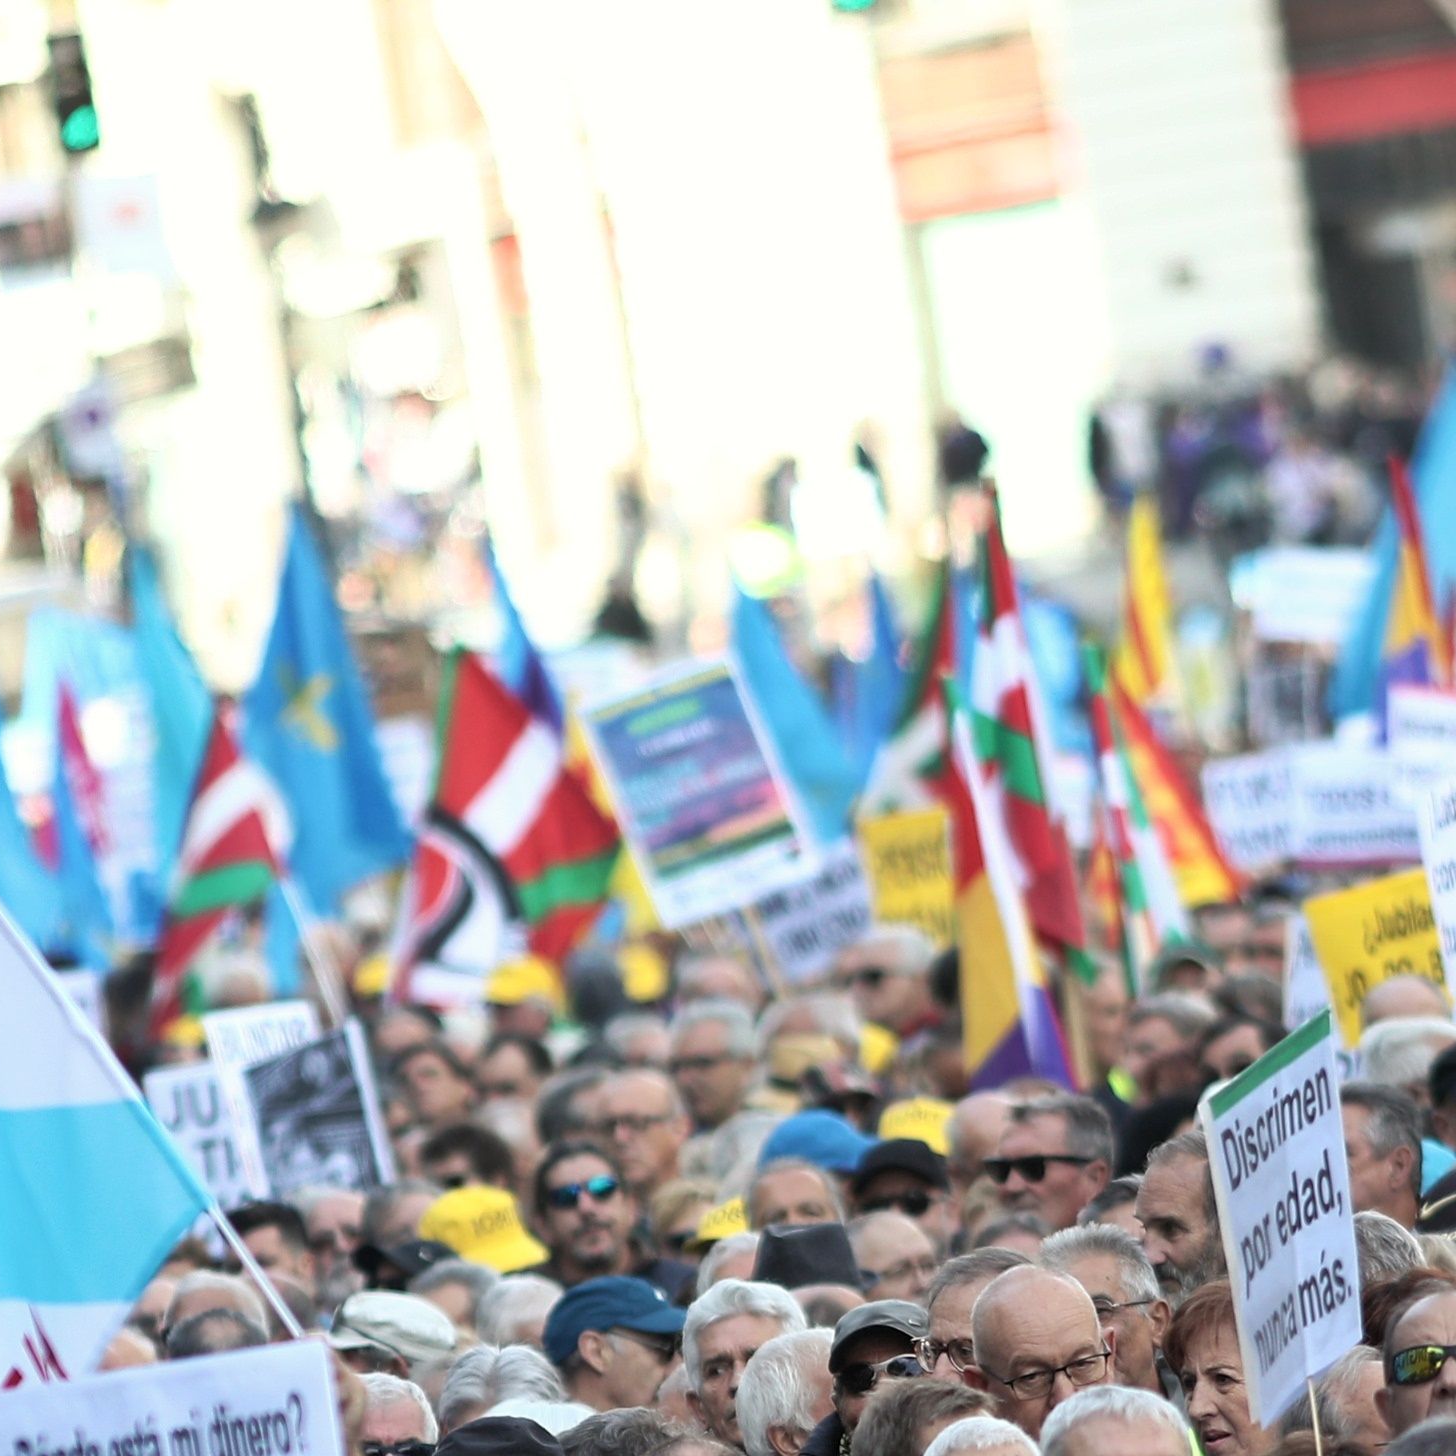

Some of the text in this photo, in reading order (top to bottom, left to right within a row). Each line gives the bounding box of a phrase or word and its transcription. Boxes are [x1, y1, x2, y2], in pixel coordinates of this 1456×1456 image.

[1220, 1065, 1332, 1193] Discrimen
[1241, 1148, 1343, 1298] por edad,
[1252, 1248, 1353, 1377] nunca más.
